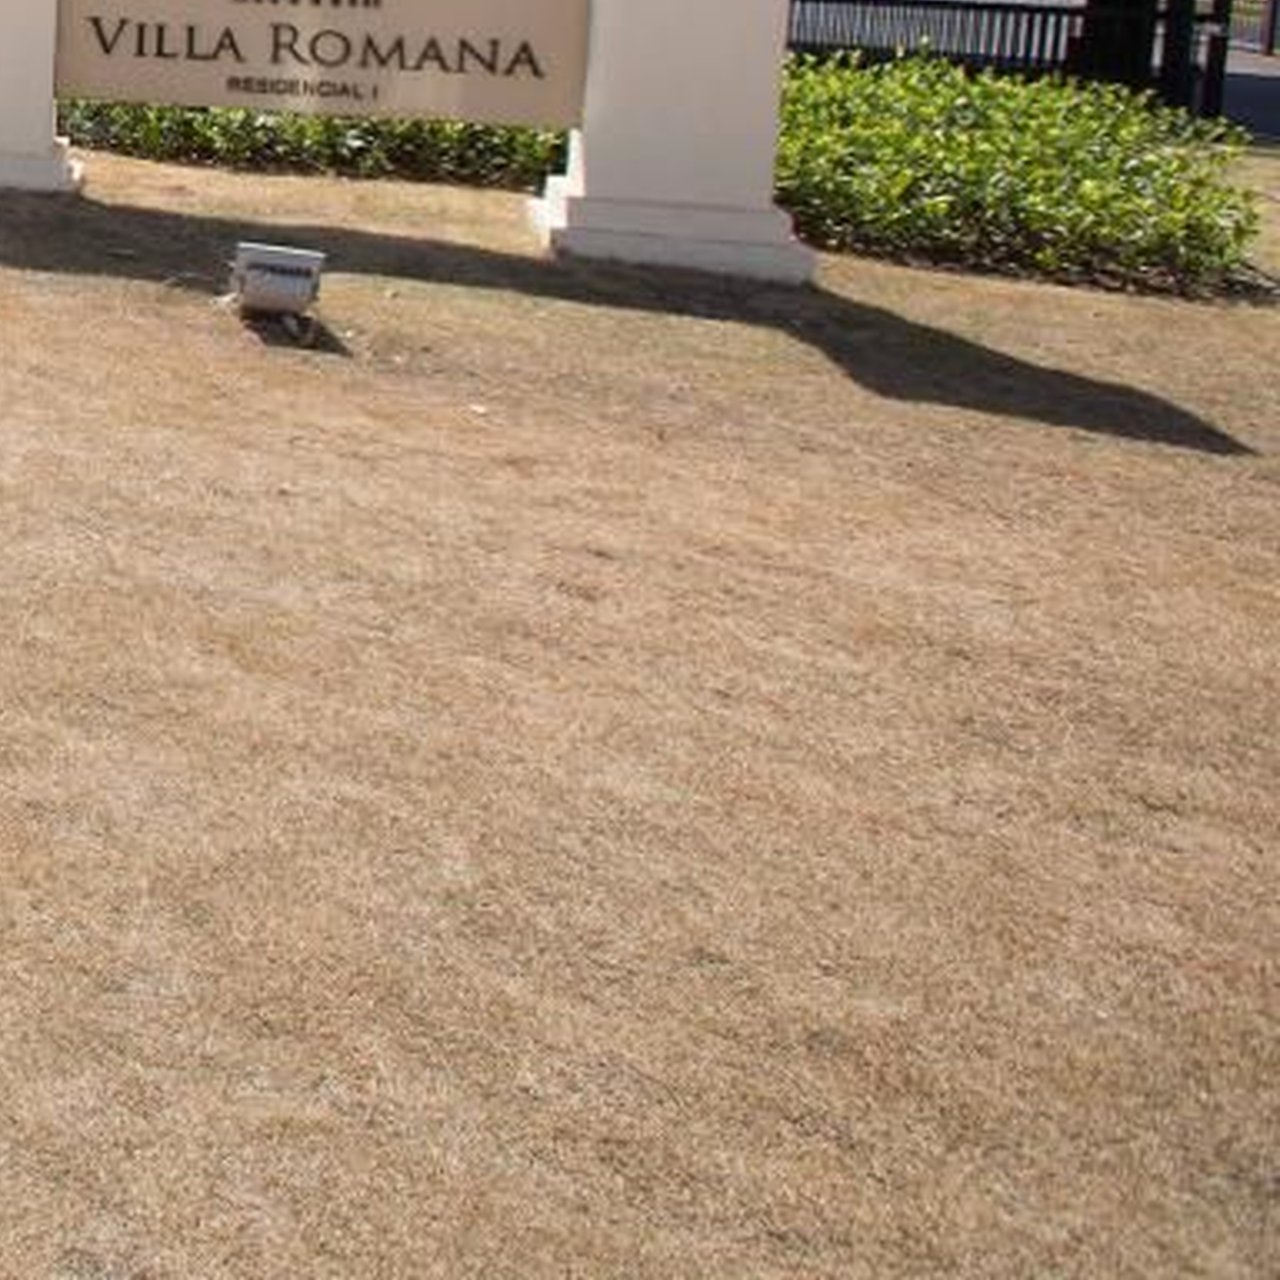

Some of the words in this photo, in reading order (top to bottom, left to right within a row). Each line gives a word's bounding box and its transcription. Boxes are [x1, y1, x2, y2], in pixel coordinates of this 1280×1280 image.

[89, 16, 246, 62] VILLA
[270, 23, 545, 78] ROMANA
[226, 75, 364, 100] RESIDENCIAL
